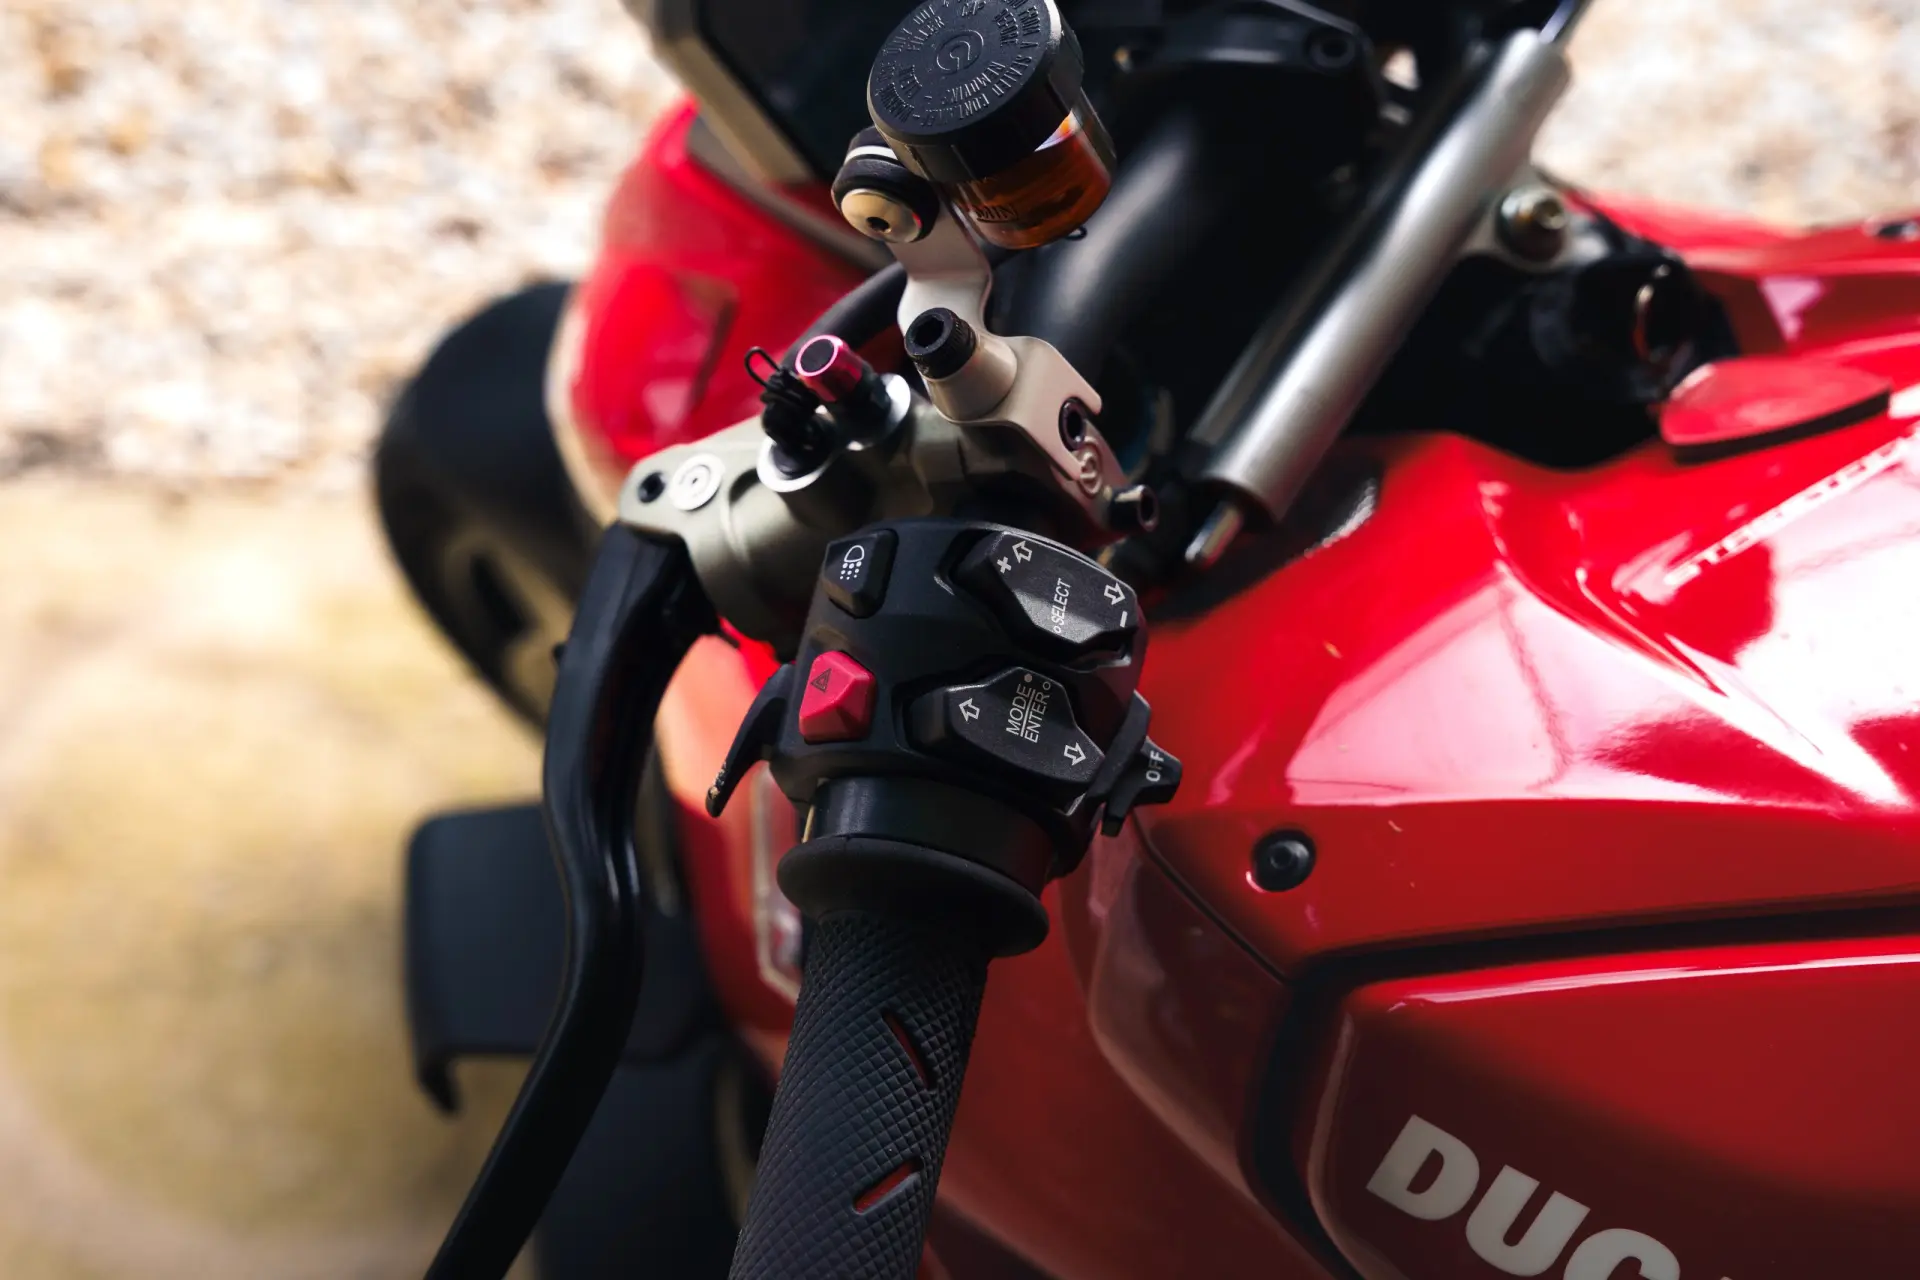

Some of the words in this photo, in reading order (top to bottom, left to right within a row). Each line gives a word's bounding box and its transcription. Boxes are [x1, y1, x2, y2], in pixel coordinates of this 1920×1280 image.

[993, 8, 1019, 48] BEFORE
[1018, 5, 1041, 37] FROM
[991, 54, 1033, 97] SEALED
[1051, 578, 1071, 626] SELECT
[1006, 683, 1032, 736] MODE
[1024, 691, 1050, 743] ENTER
[1146, 750, 1164, 782] OFF
[1366, 1114, 1733, 1280] DUC
